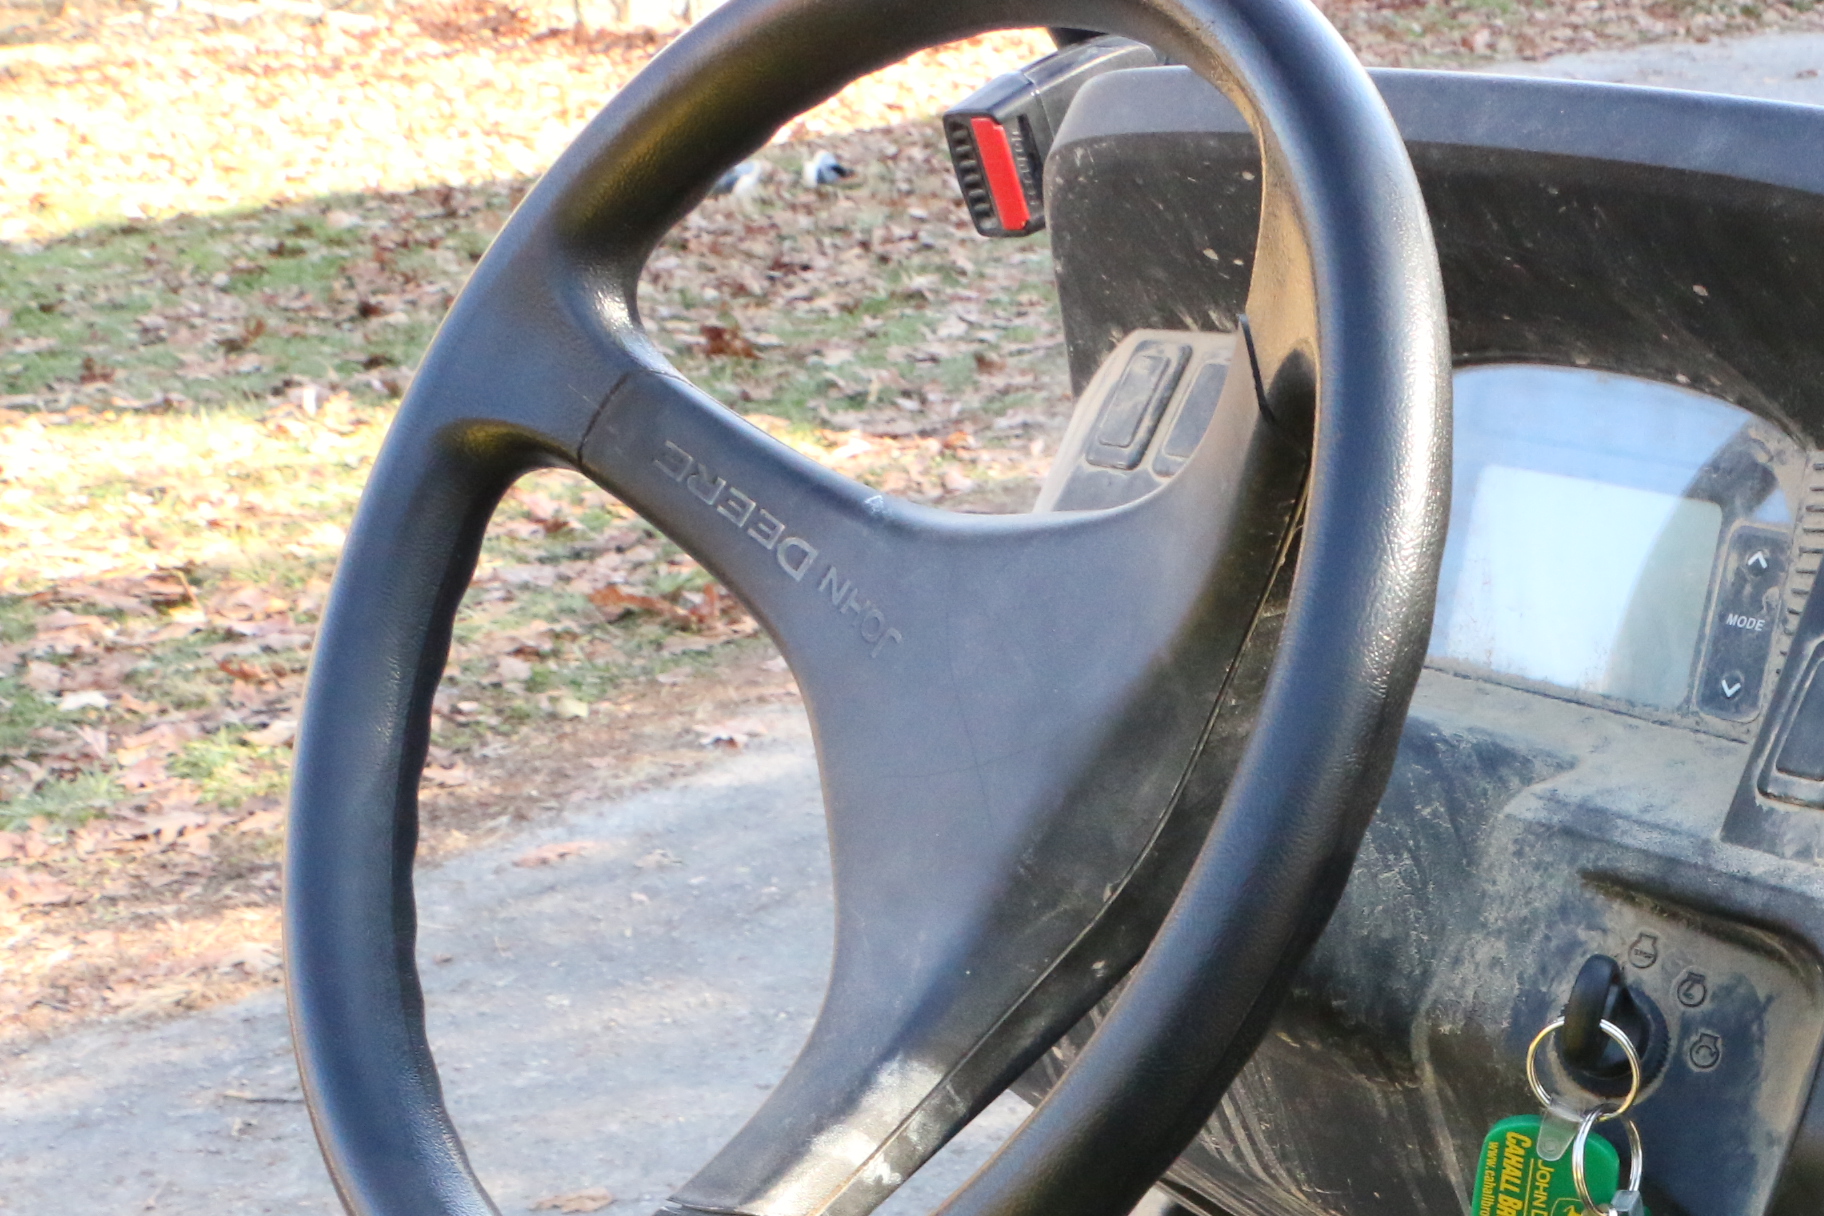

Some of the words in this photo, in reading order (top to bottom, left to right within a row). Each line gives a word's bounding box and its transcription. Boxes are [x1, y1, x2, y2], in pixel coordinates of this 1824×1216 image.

[653, 440, 818, 582] DEERE
[817, 565, 902, 659] JOHN
[1725, 612, 1766, 633] MODE
[1499, 1131, 1533, 1193] CAHALL
[1532, 1159, 1555, 1208] JOHN
